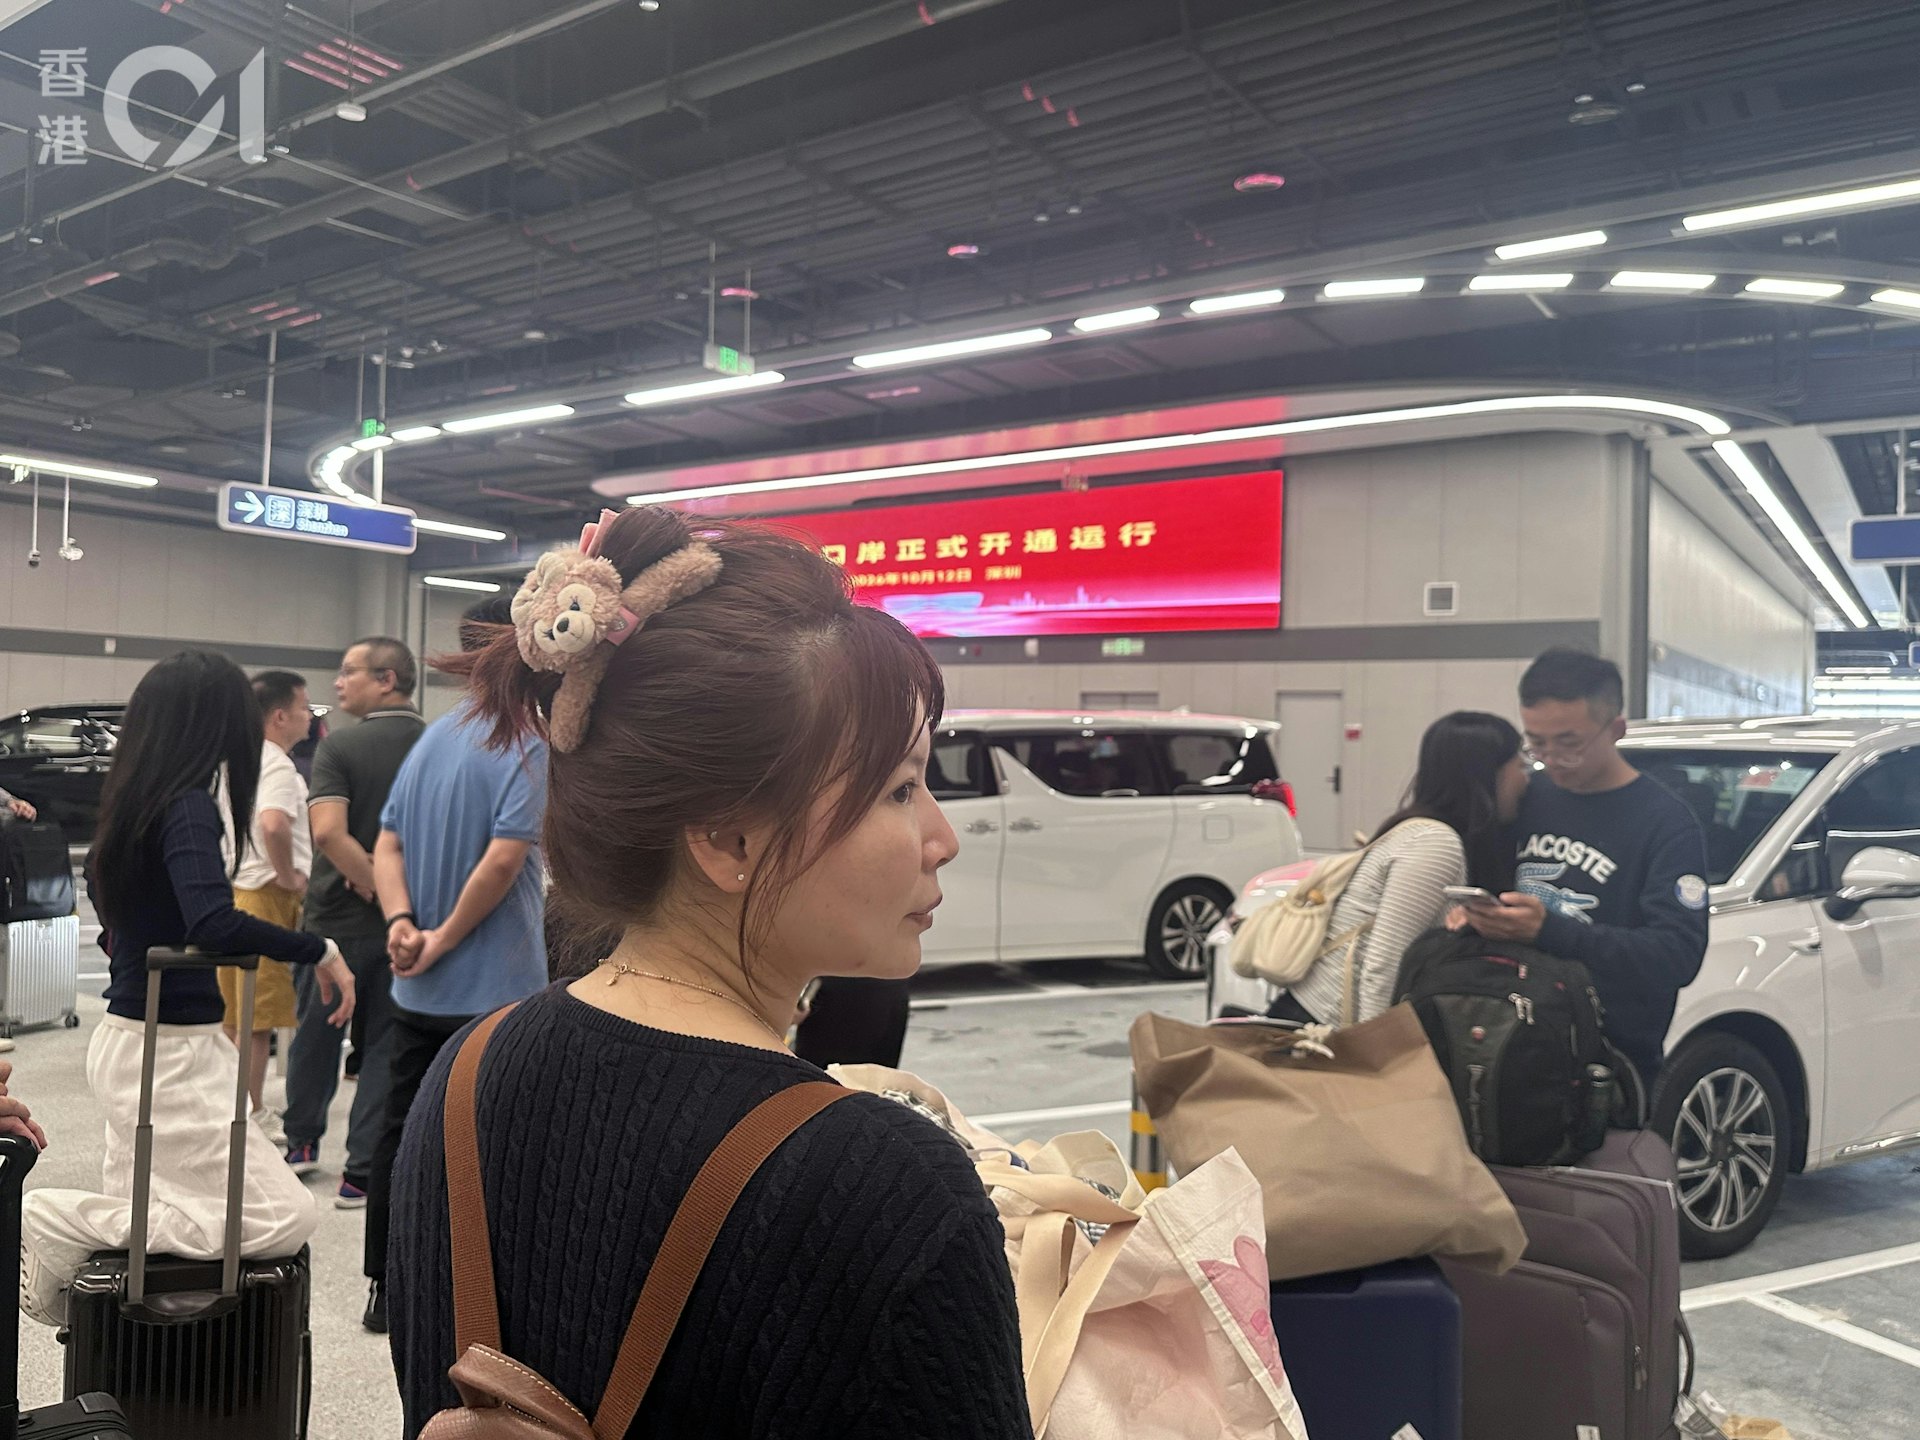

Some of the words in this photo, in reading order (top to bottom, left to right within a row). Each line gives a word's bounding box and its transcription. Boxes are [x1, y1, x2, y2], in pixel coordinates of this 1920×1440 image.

[297, 500, 328, 521] 深圳
[296, 517, 348, 537] Shenzhen
[821, 521, 1156, 566] 口岸正式开通运行
